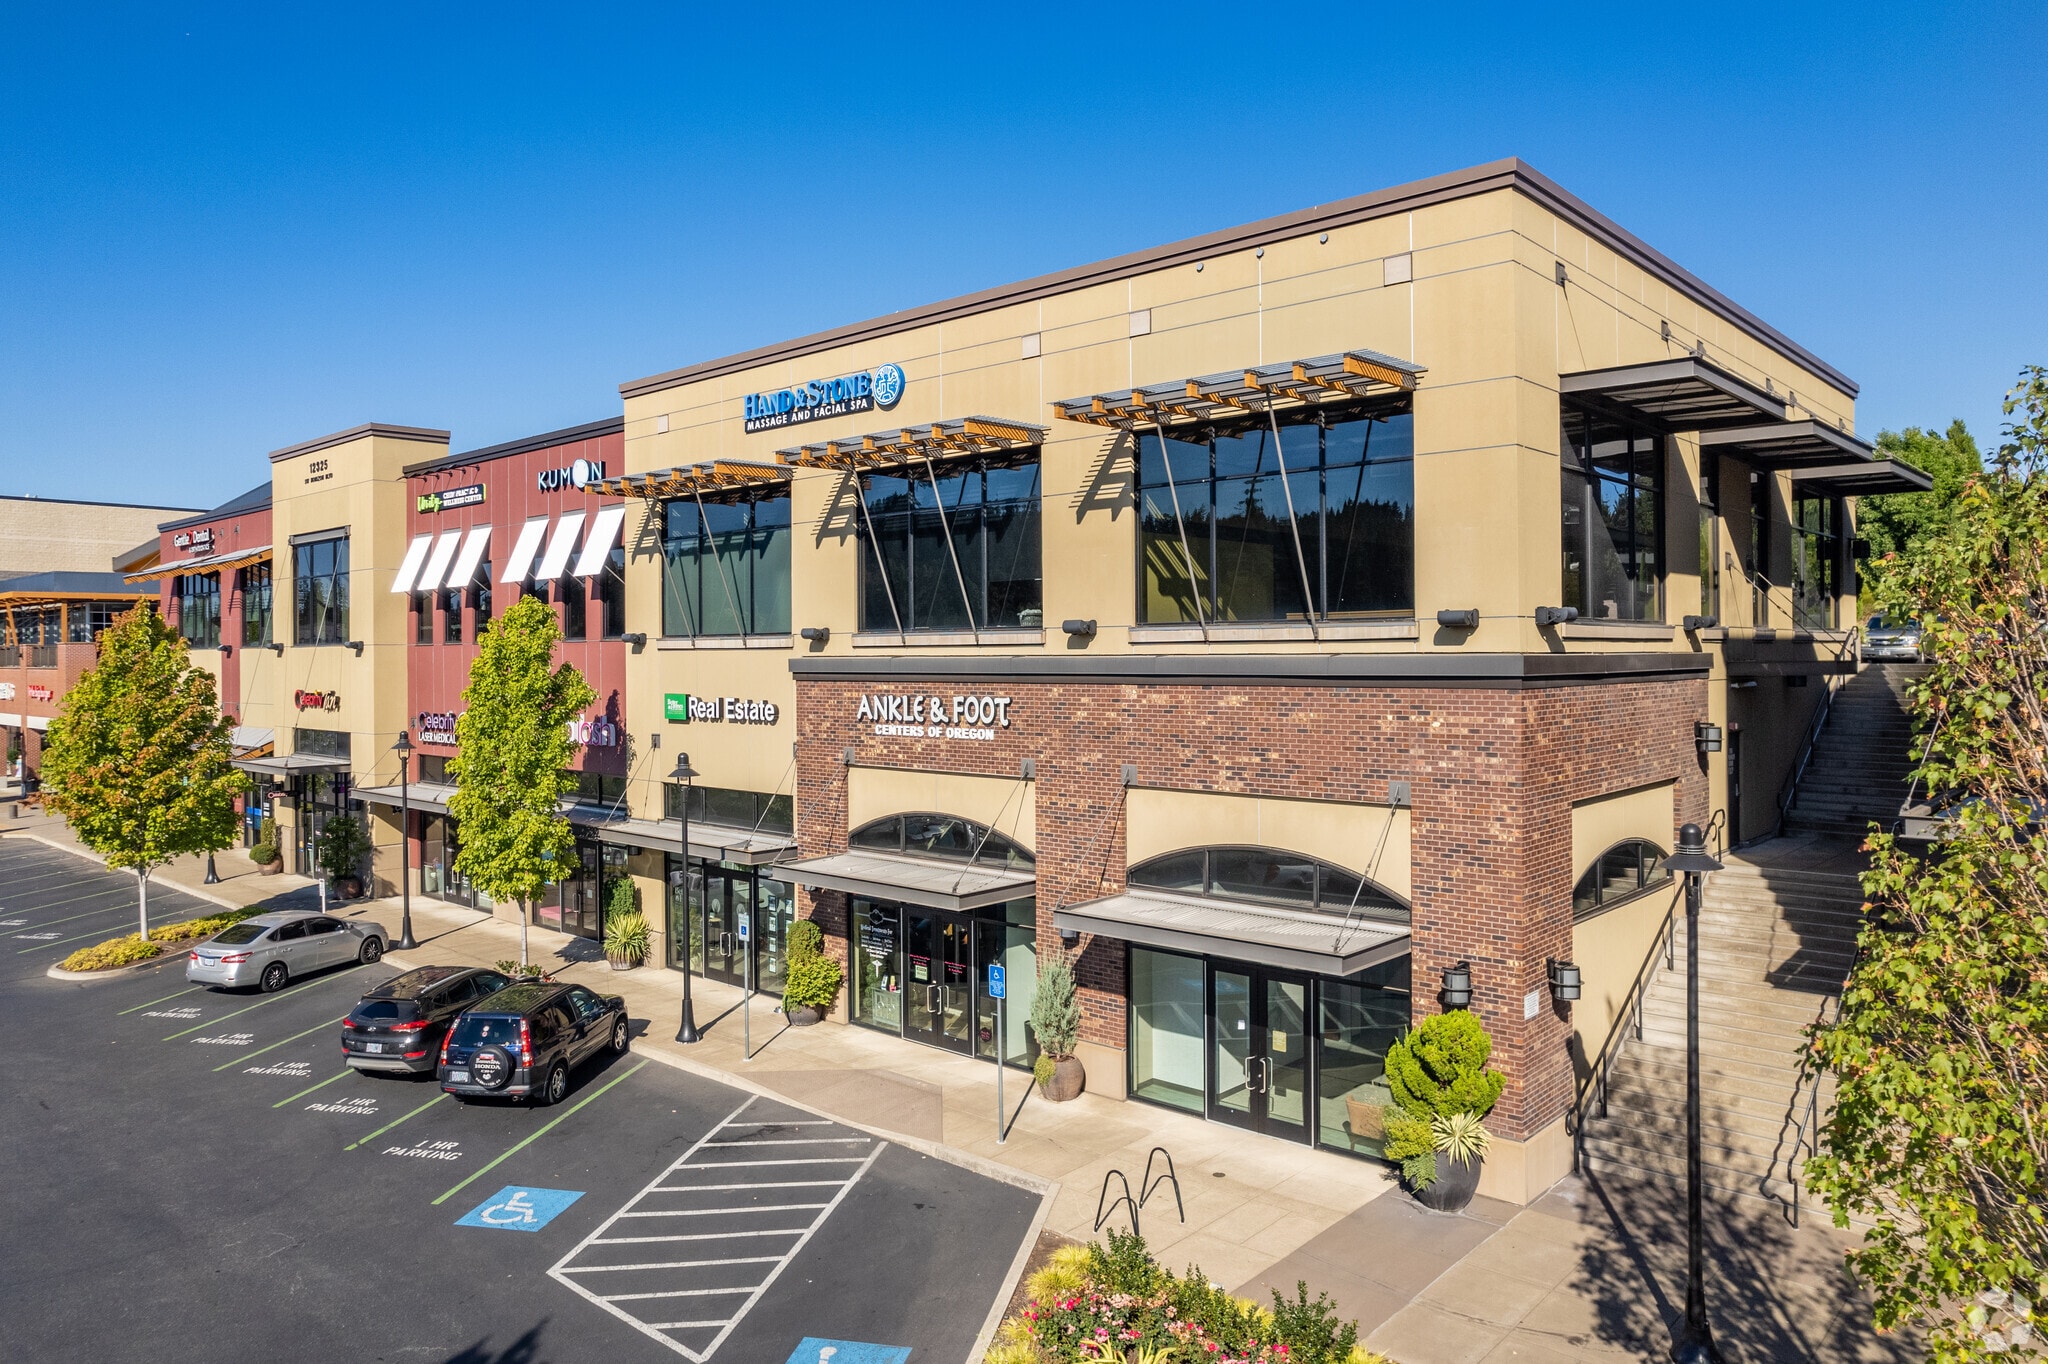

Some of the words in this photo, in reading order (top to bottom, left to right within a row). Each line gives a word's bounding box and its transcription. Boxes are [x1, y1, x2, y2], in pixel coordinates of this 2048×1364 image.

[743, 389, 795, 420] HAND
[806, 372, 873, 407] STONE
[747, 414, 788, 431] MASSAGE
[791, 410, 810, 422] AND
[814, 403, 847, 418] FACIAL
[850, 398, 868, 411] SPA
[309, 459, 328, 473] 12325
[538, 459, 602, 490] KUMON
[688, 697, 720, 719] Real
[725, 698, 775, 721] Estate
[856, 694, 924, 722] ANKLE
[930, 697, 949, 723] &
[953, 696, 1010, 727] FOOT
[418, 732, 434, 742] LASER
[434, 733, 456, 744] MEDICAL
[875, 724, 924, 737] CENTERS
[928, 726, 943, 738] OF
[946, 727, 994, 740] OREGON
[242, 1066, 312, 1076] PARKING
[304, 1103, 379, 1115] PARKING
[348, 1098, 377, 1106] HR
[415, 1140, 429, 1148] 1
[428, 1141, 459, 1150] HR
[381, 1146, 463, 1161] PARKING
